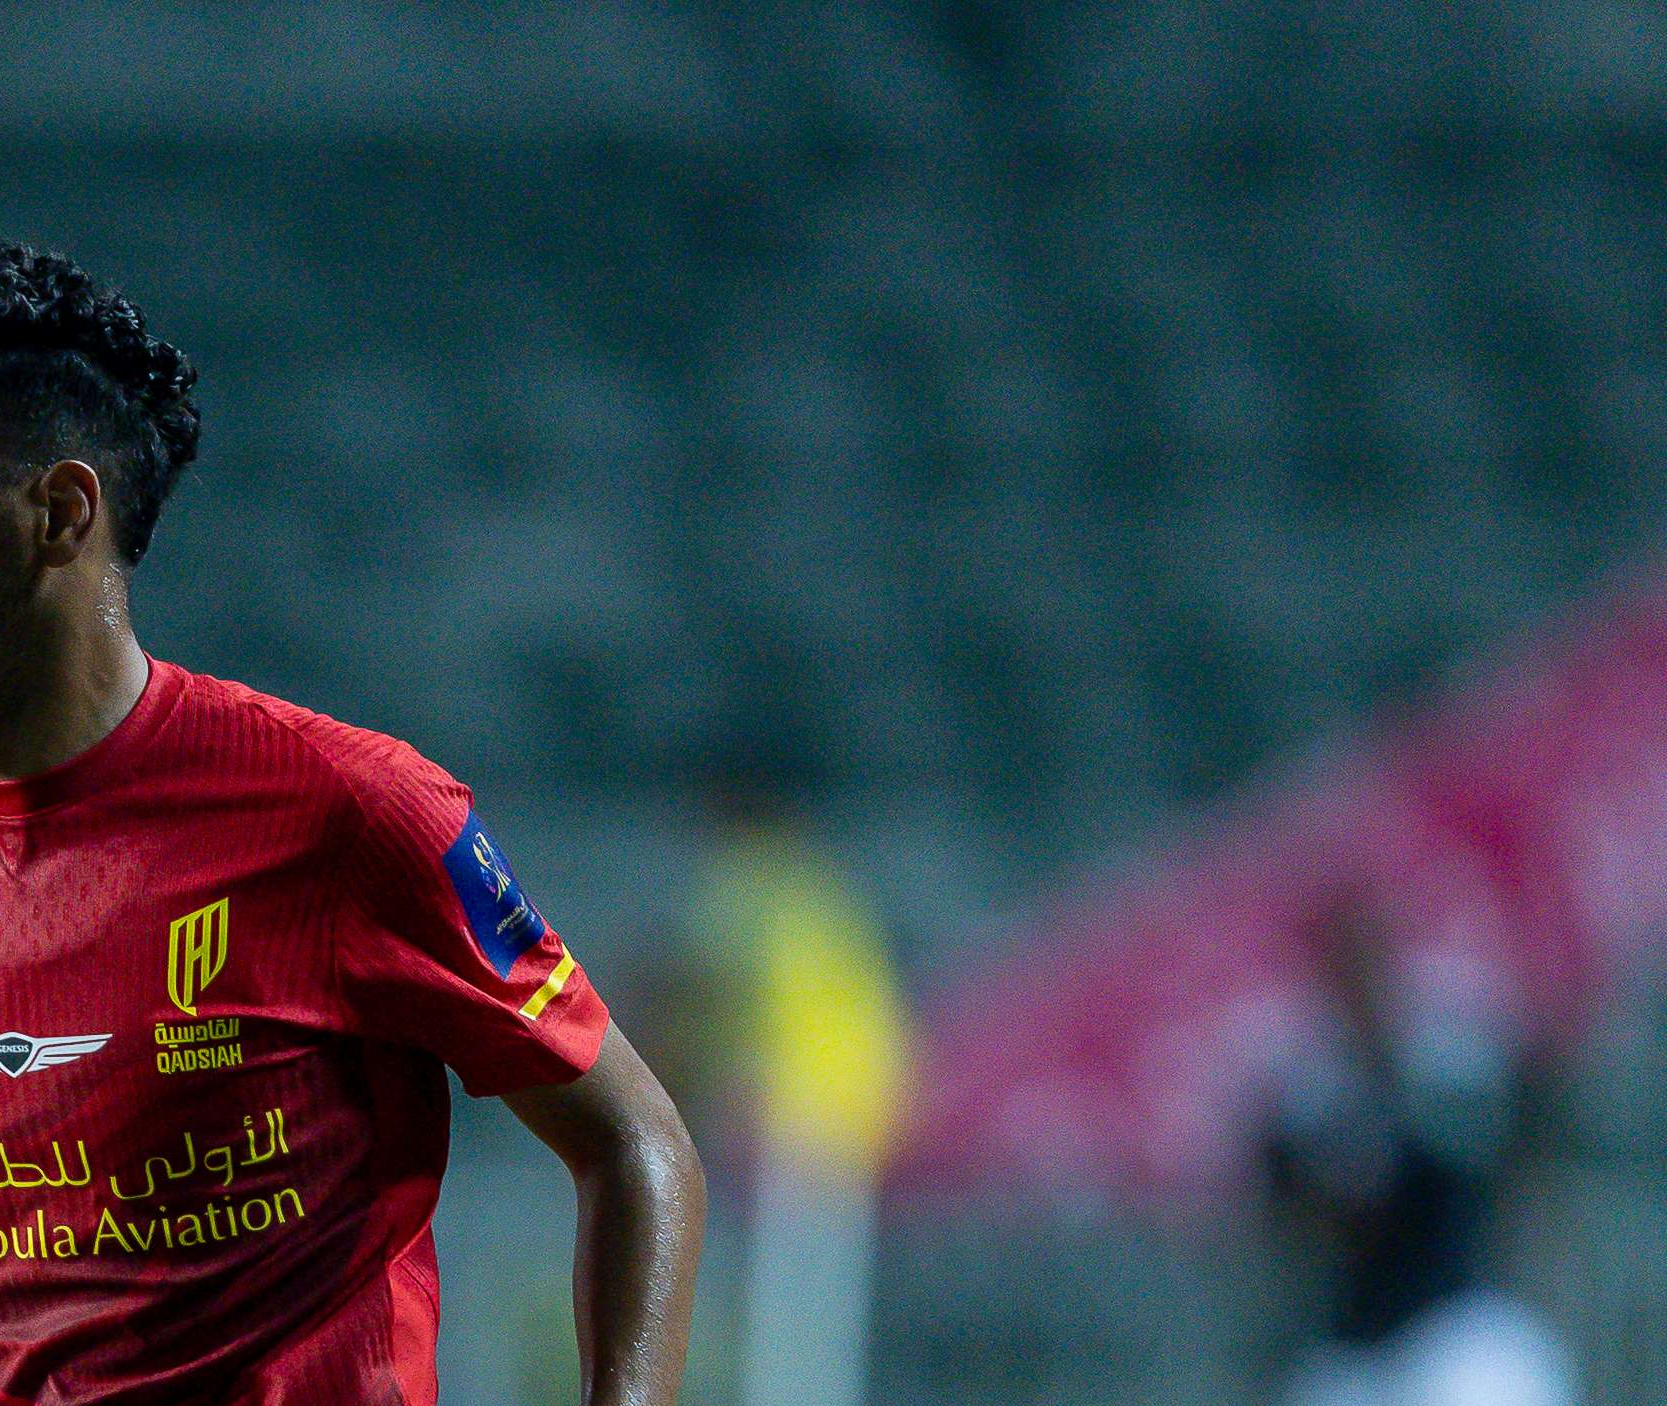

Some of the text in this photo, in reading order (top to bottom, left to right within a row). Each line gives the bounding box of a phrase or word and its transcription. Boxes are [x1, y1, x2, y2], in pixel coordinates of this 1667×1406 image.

[154, 1018, 240, 1049] القادسية
[157, 1043, 243, 1075] QADSIAH
[109, 1108, 290, 1200] الأولى
[91, 1186, 306, 1256] Aviation
